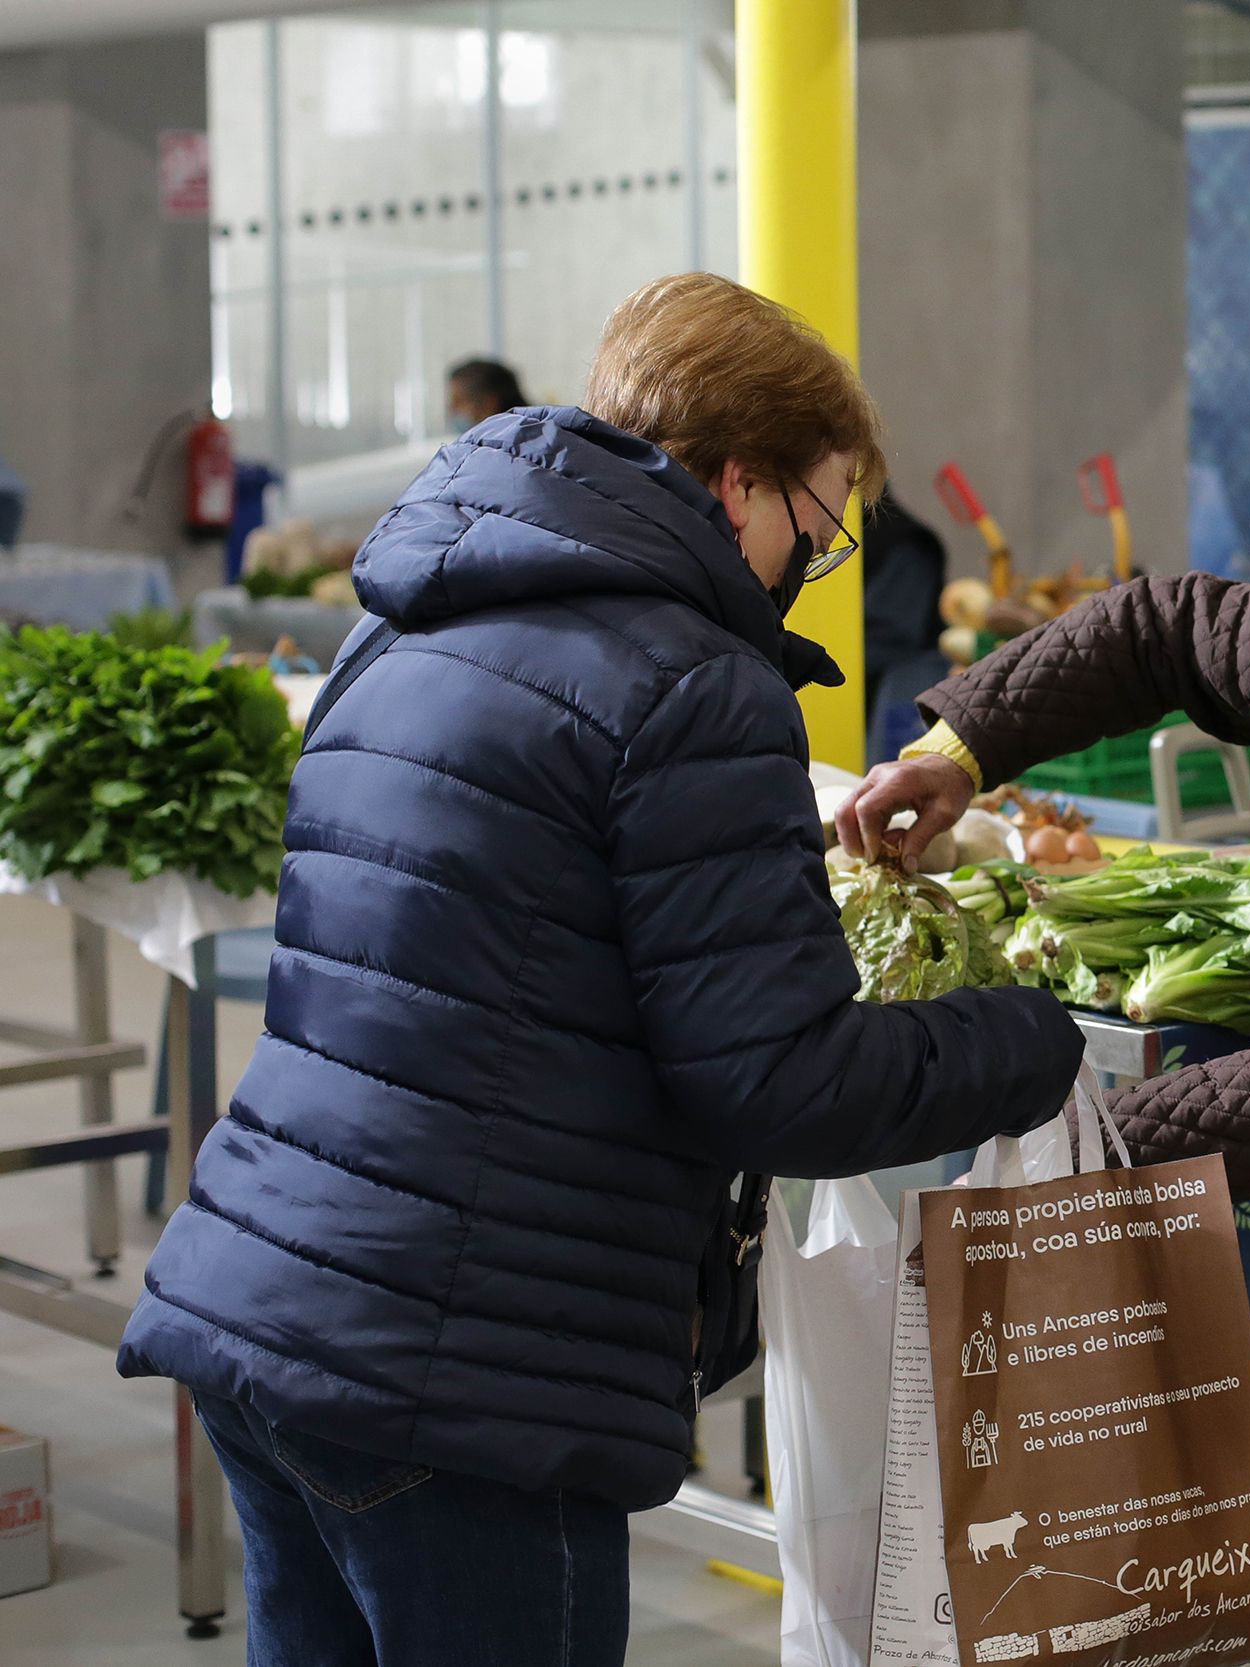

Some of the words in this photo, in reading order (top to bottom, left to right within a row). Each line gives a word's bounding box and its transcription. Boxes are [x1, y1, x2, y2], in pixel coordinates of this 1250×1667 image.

[951, 1207, 967, 1228] A
[971, 1209, 1010, 1232] persoa
[1015, 1186, 1133, 1229] propietaria
[1154, 1177, 1206, 1202] bolsa
[966, 1240, 1026, 1267] apostou,
[1033, 1232, 1078, 1253] coa
[1084, 1221, 1122, 1244] súa
[1164, 1213, 1201, 1238] por:
[1002, 1323, 1037, 1339] Uns
[1043, 1308, 1120, 1333] Ancares
[1007, 1353, 1019, 1366] e
[1023, 1343, 1078, 1363] libres
[1083, 1336, 1109, 1353] de
[1018, 1411, 1045, 1429] 215
[1049, 1392, 1165, 1422] cooperativistas
[1175, 1388, 1190, 1401] seu
[1191, 1376, 1240, 1400] proxecto
[1024, 1436, 1045, 1452] de
[1048, 1430, 1084, 1448] vida
[1088, 1428, 1110, 1441] no
[1114, 1416, 1148, 1437] rural
[1039, 1512, 1051, 1526] O
[1058, 1503, 1120, 1523] benestar
[1123, 1498, 1148, 1511] das
[1151, 1491, 1181, 1507] nosas
[1182, 1486, 1206, 1499] vacas,
[1043, 1532, 1070, 1549] que
[1074, 1524, 1111, 1541] están
[1114, 1518, 1152, 1533] todos
[1155, 1514, 1169, 1526] os
[1192, 1505, 1203, 1518] do
[1204, 1502, 1218, 1515] ano
[1219, 1497, 1237, 1510] nos
[1142, 1608, 1183, 1631] sabor
[1187, 1599, 1211, 1619] dos
